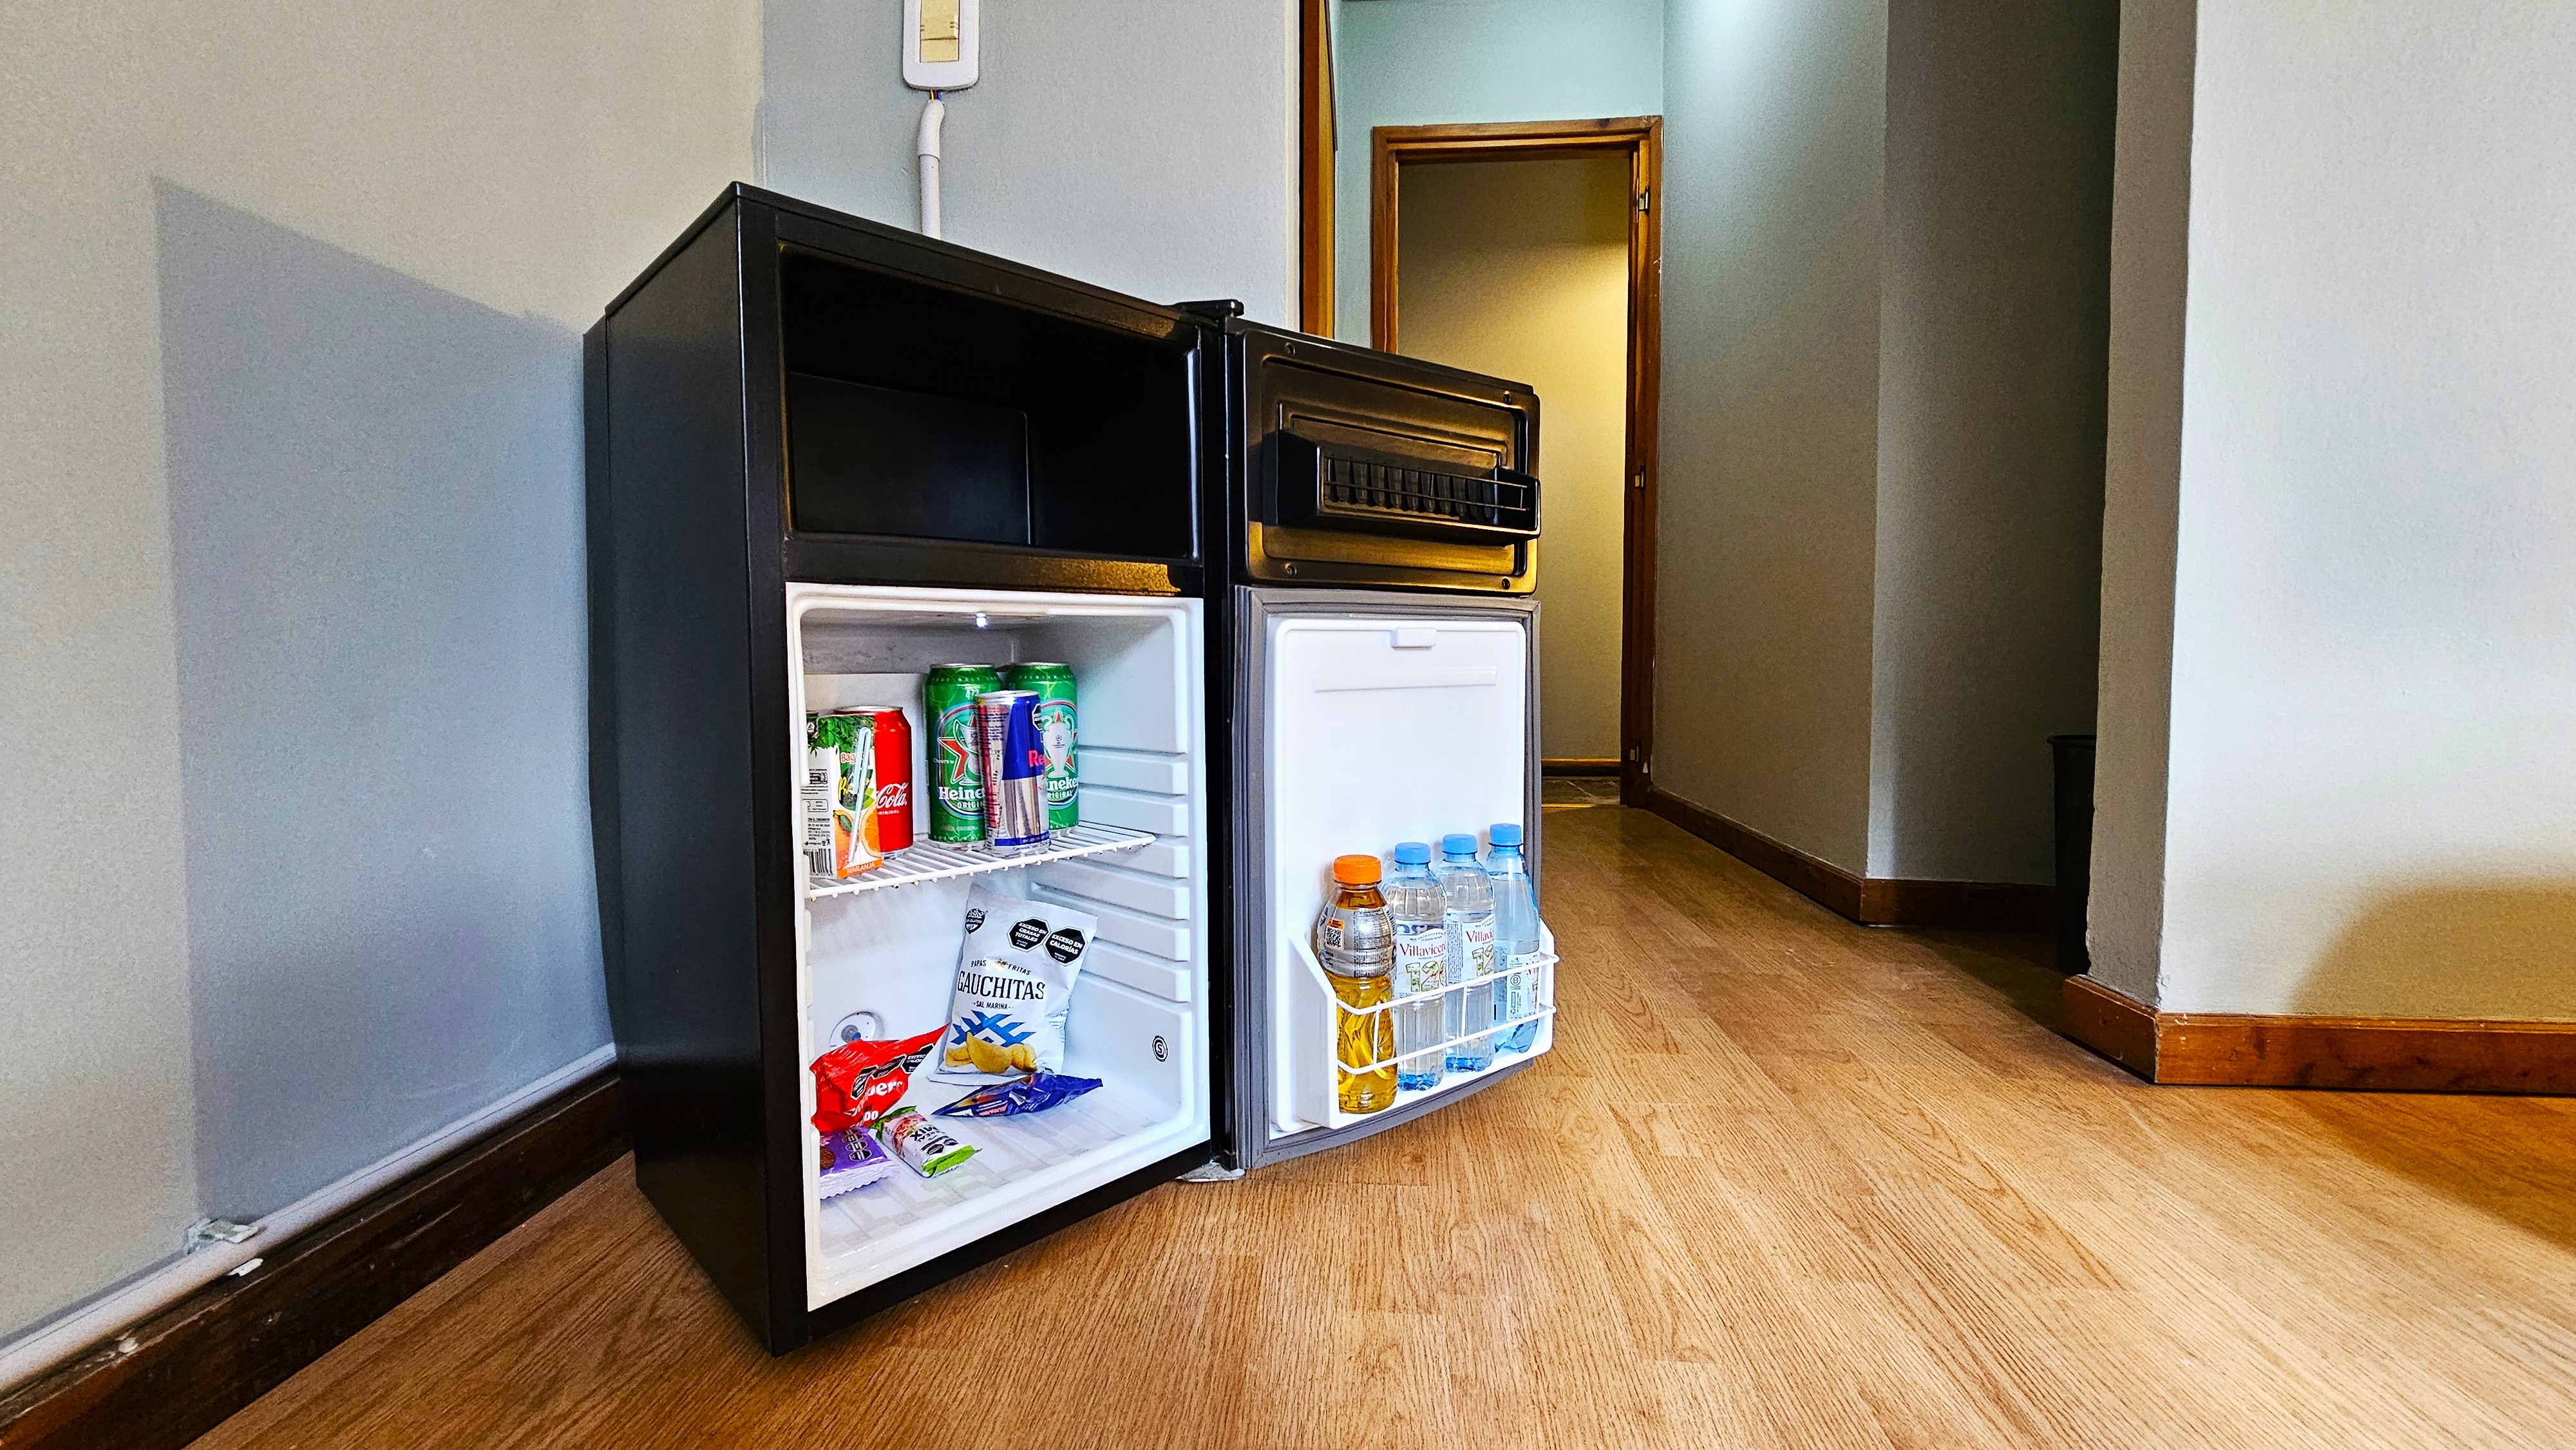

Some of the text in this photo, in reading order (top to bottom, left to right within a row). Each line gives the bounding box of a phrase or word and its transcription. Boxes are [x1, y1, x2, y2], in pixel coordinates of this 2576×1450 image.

[847, 862, 875, 874] NARANJA
[1018, 922, 1039, 932] EXCESO
[1019, 928, 1041, 937] GRASAS
[1015, 932, 1038, 942] TOTALES
[1051, 934, 1083, 949] EXCESO EN
[1465, 928, 1493, 943] Villavi
[1050, 940, 1079, 955] CALORÍAS
[971, 959, 1031, 976] PAPAS FRITAS
[957, 970, 1046, 1000] GAUCHITAS
[976, 1000, 985, 1008] SAL
